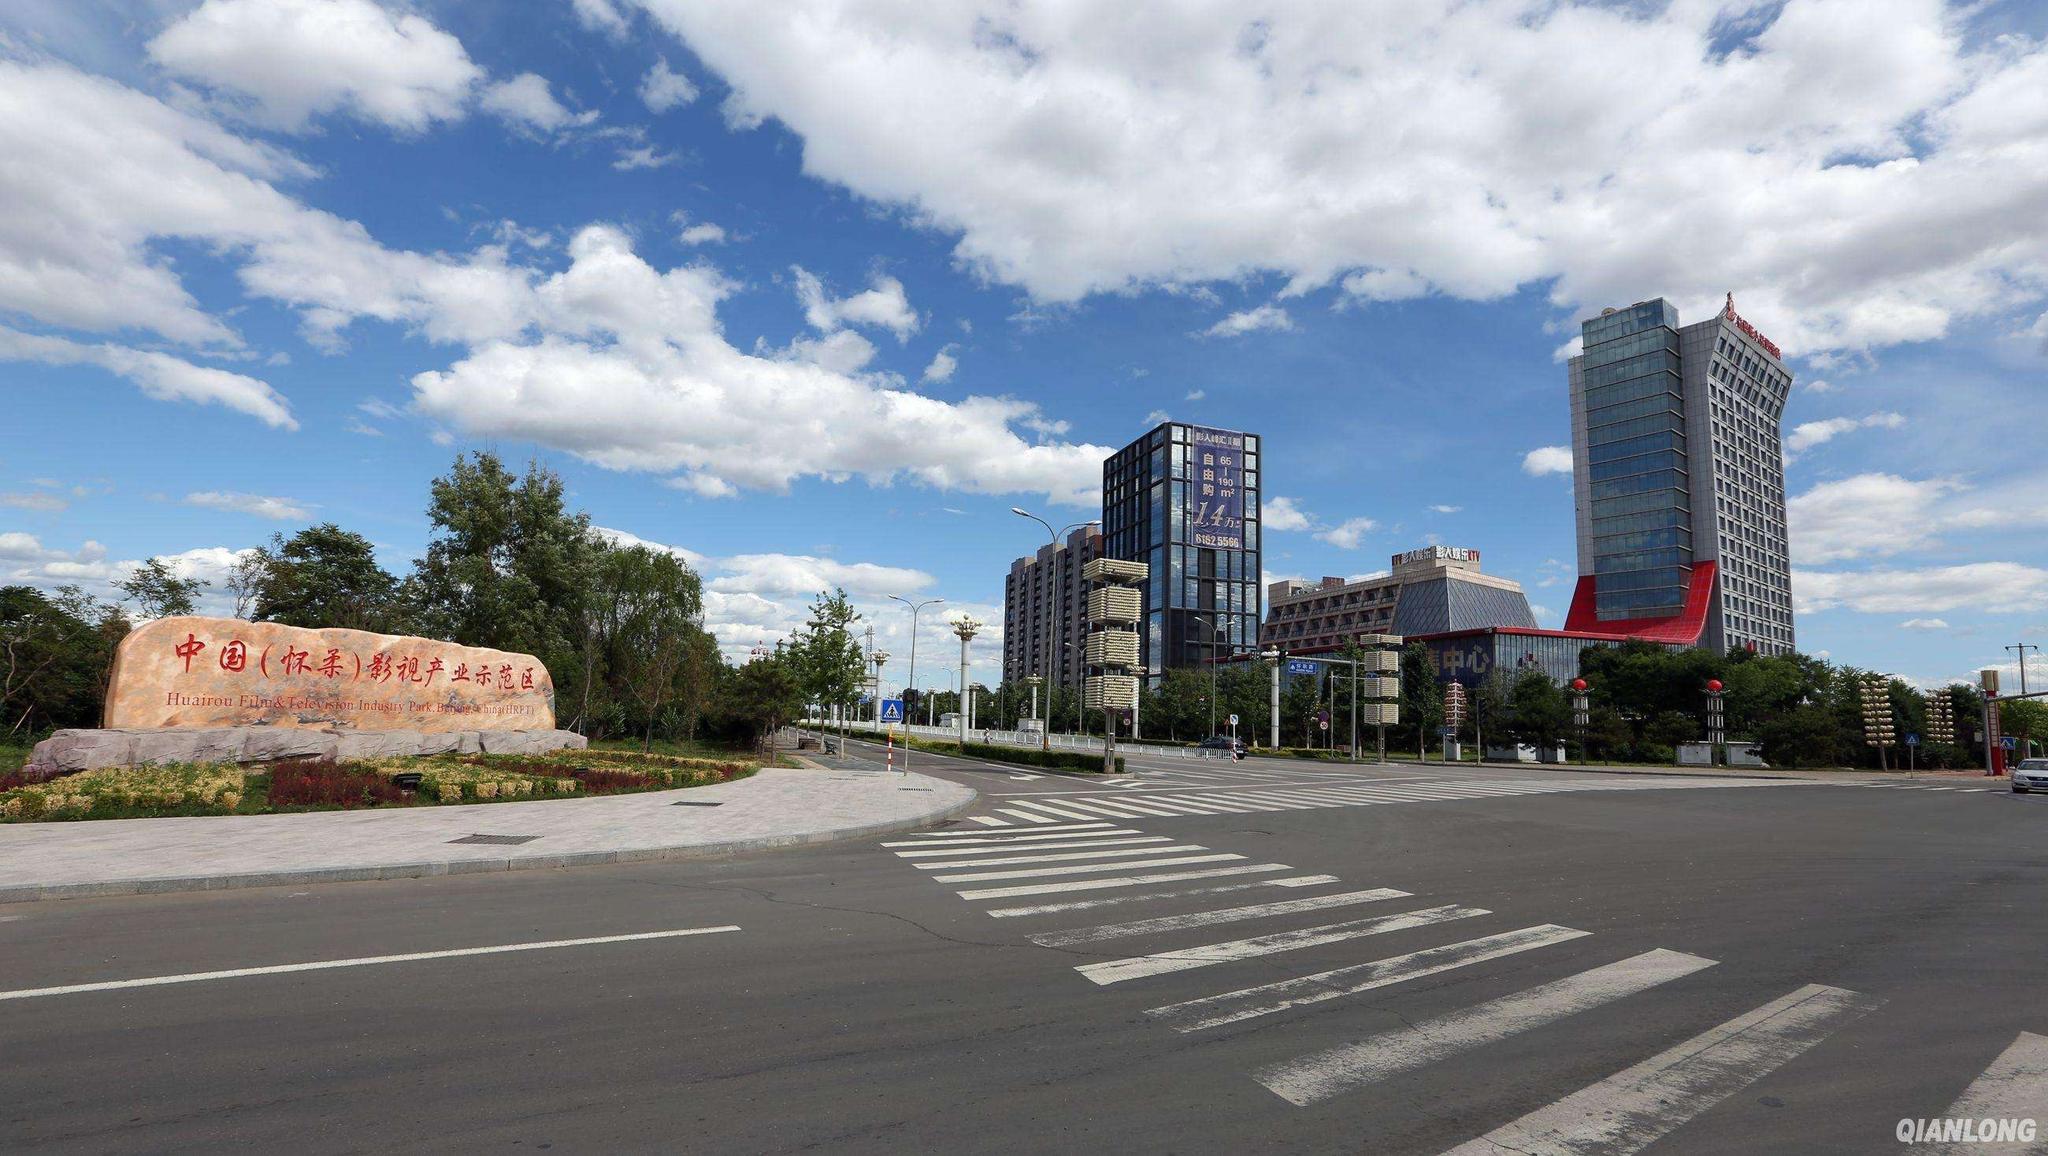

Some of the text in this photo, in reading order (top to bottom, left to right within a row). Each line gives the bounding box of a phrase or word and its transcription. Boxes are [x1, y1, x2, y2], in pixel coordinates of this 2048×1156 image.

[1203, 453, 1214, 497] 自由购
[1218, 477, 1234, 487] 190
[166, 692, 233, 707] Huairou
[359, 699, 403, 714] Industry
